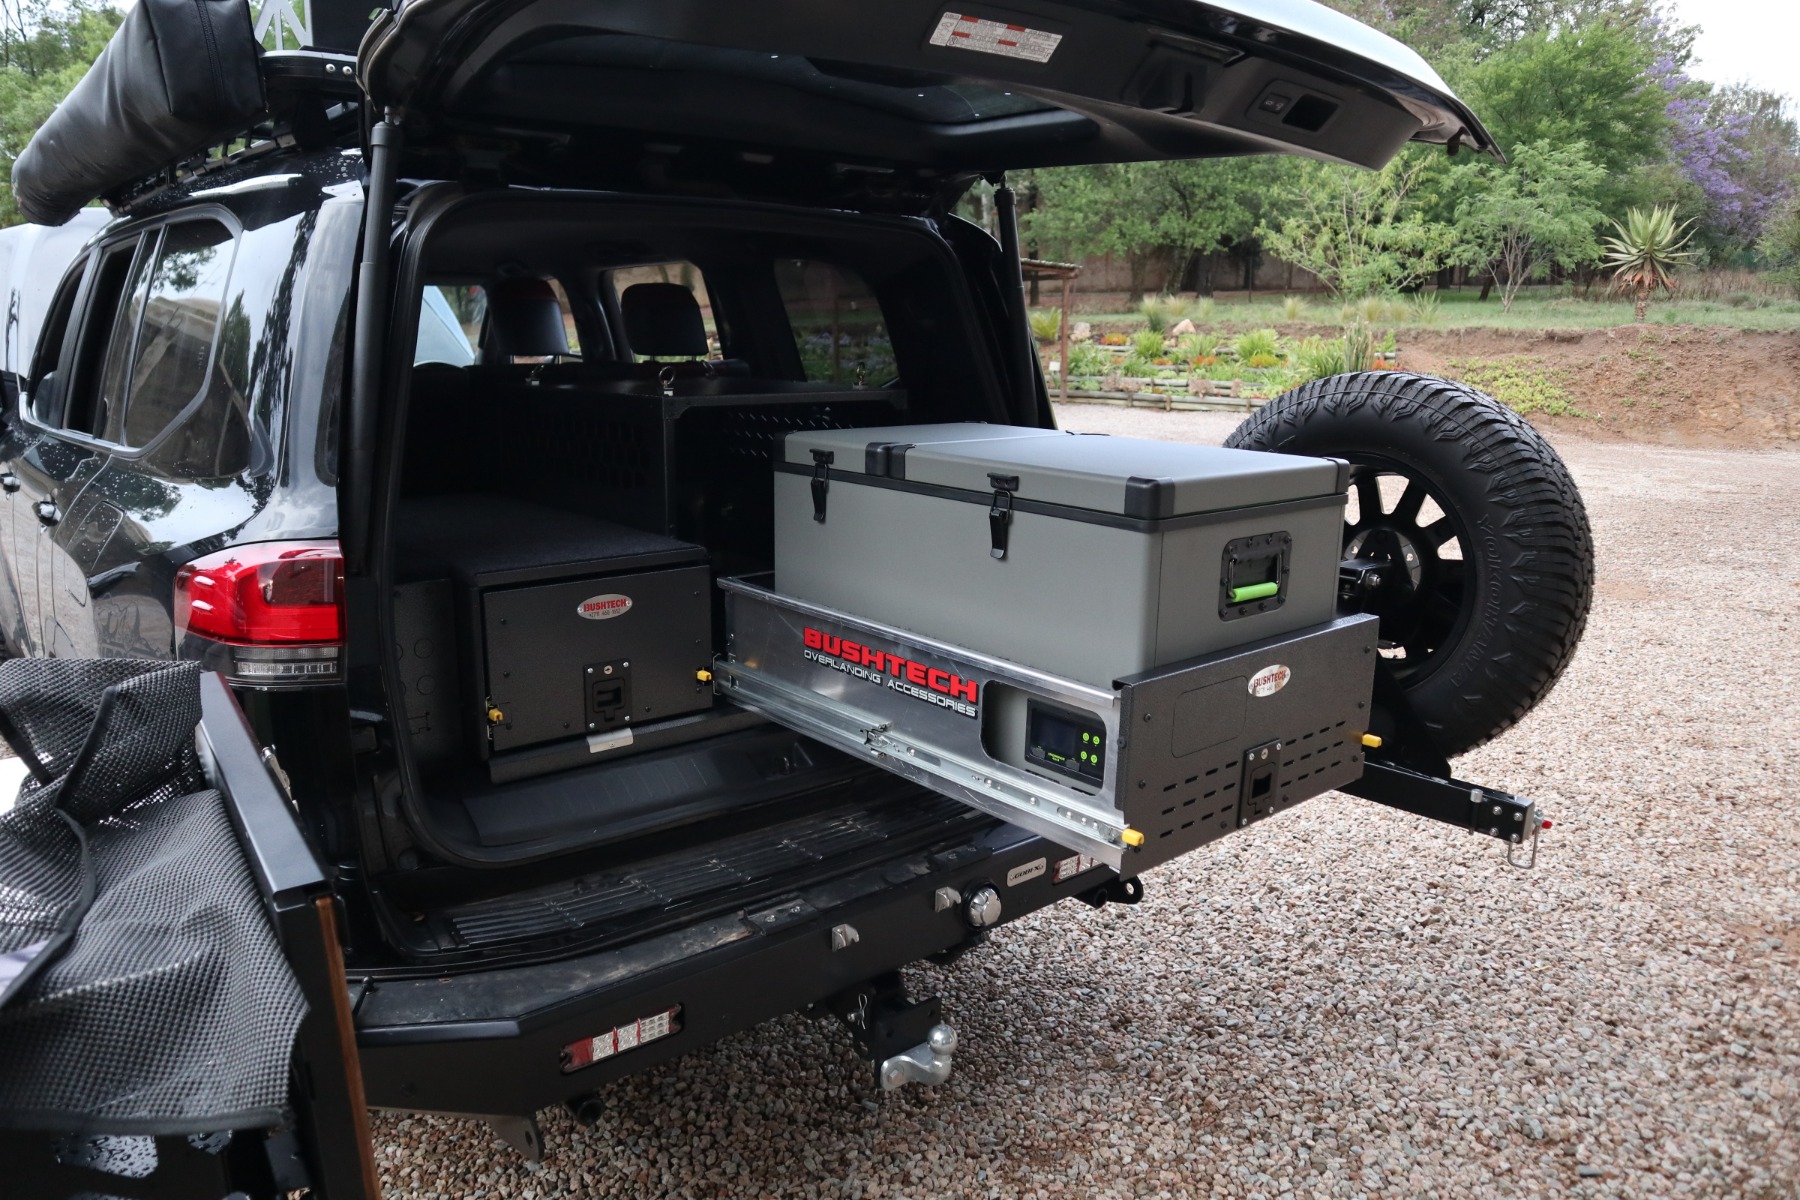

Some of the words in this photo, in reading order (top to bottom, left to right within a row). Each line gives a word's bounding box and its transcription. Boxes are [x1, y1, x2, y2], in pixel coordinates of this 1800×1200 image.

[584, 599, 626, 612] BUSHTECH
[1449, 513, 1504, 688] YOKOHAMA
[802, 626, 979, 705] BUSHTECH
[803, 649, 882, 686] OVERLANDING
[886, 679, 978, 719] ACCESSORIES
[1253, 670, 1286, 688] BUSHTECH
